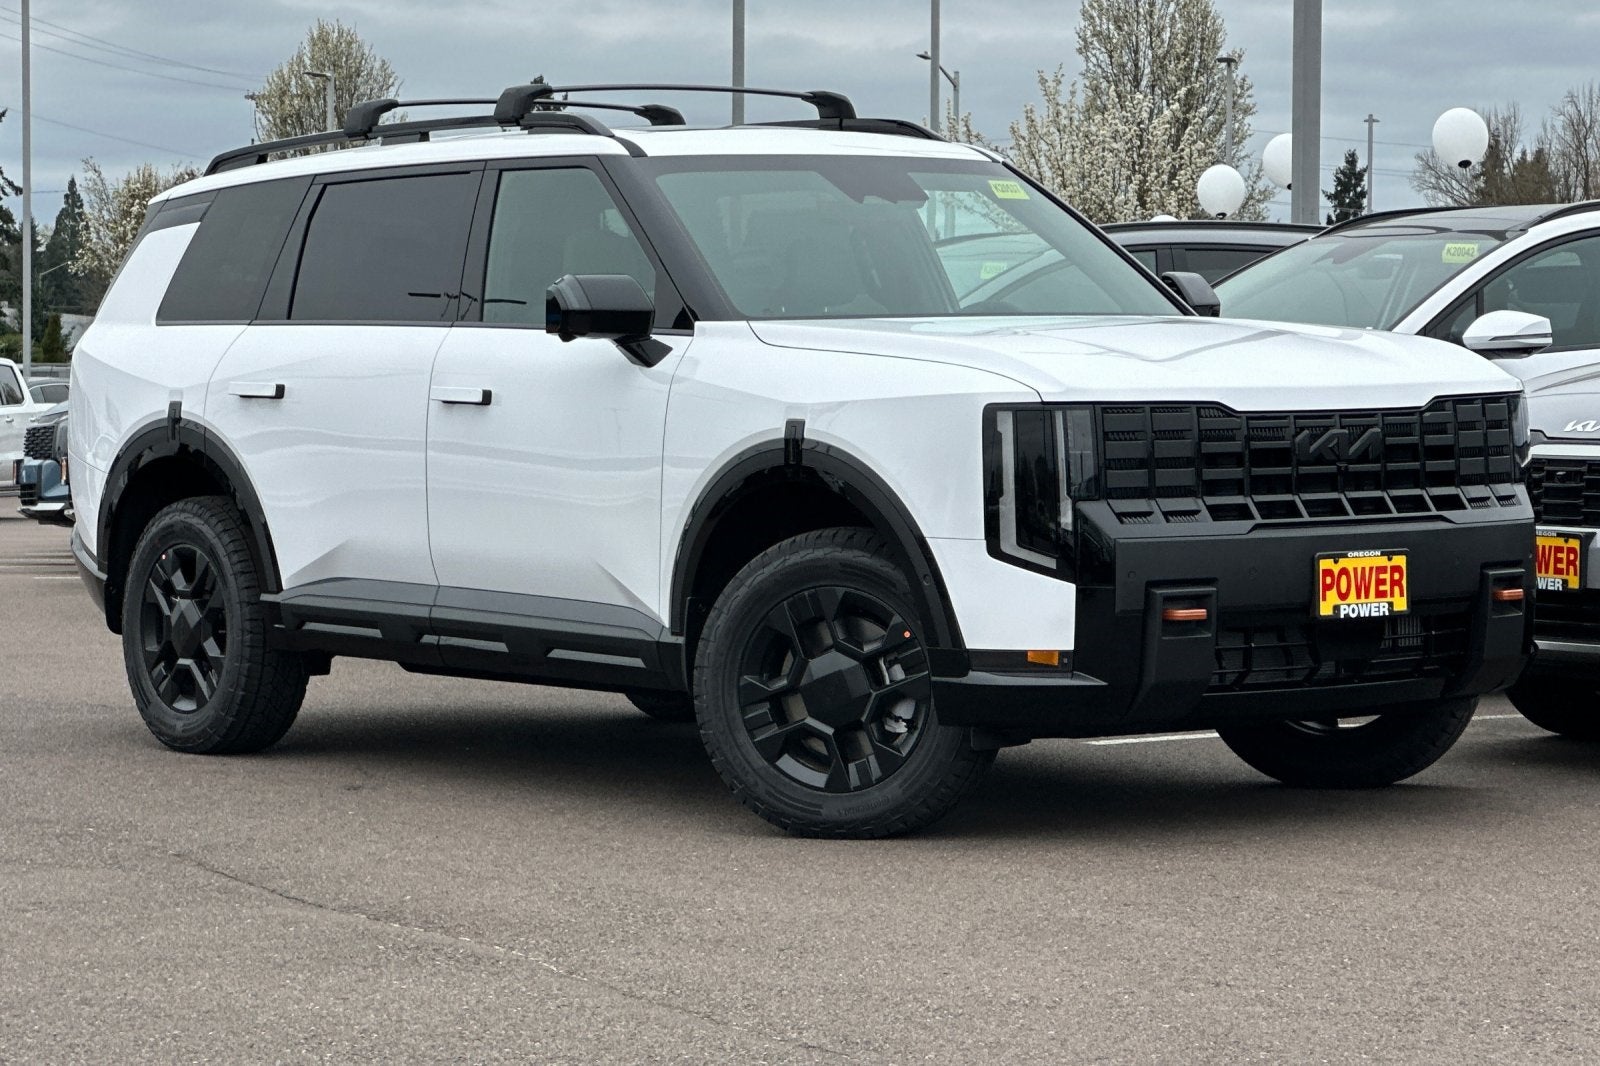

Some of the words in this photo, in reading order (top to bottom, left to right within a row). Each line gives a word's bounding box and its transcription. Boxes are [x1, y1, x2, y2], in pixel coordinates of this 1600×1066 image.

[1446, 246, 1475, 257] K20042
[1536, 544, 1578, 577] WER
[1321, 565, 1405, 602] POWER
[1536, 577, 1563, 591] WER
[1340, 602, 1389, 619] POWER
